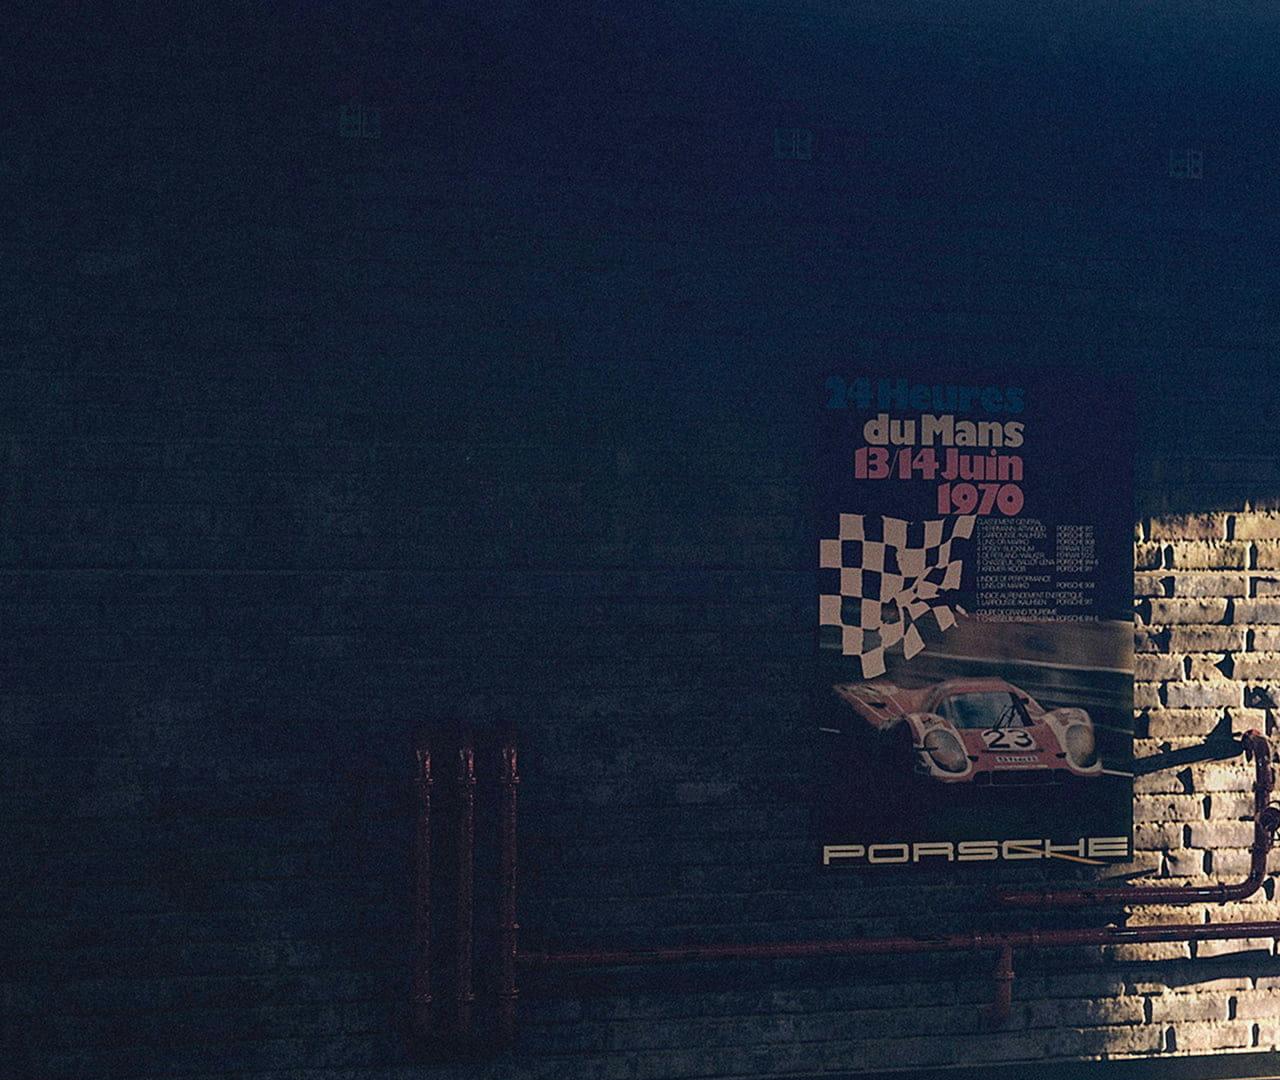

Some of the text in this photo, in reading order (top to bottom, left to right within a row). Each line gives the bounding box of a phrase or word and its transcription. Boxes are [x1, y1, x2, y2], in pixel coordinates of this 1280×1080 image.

[877, 376, 1025, 413] Heures
[863, 413, 1025, 447] du Mans
[855, 447, 1024, 482] 13/14 Juin
[937, 482, 1025, 516] 1970
[983, 729, 1033, 748] 23
[823, 836, 1129, 865] PORSCHE
